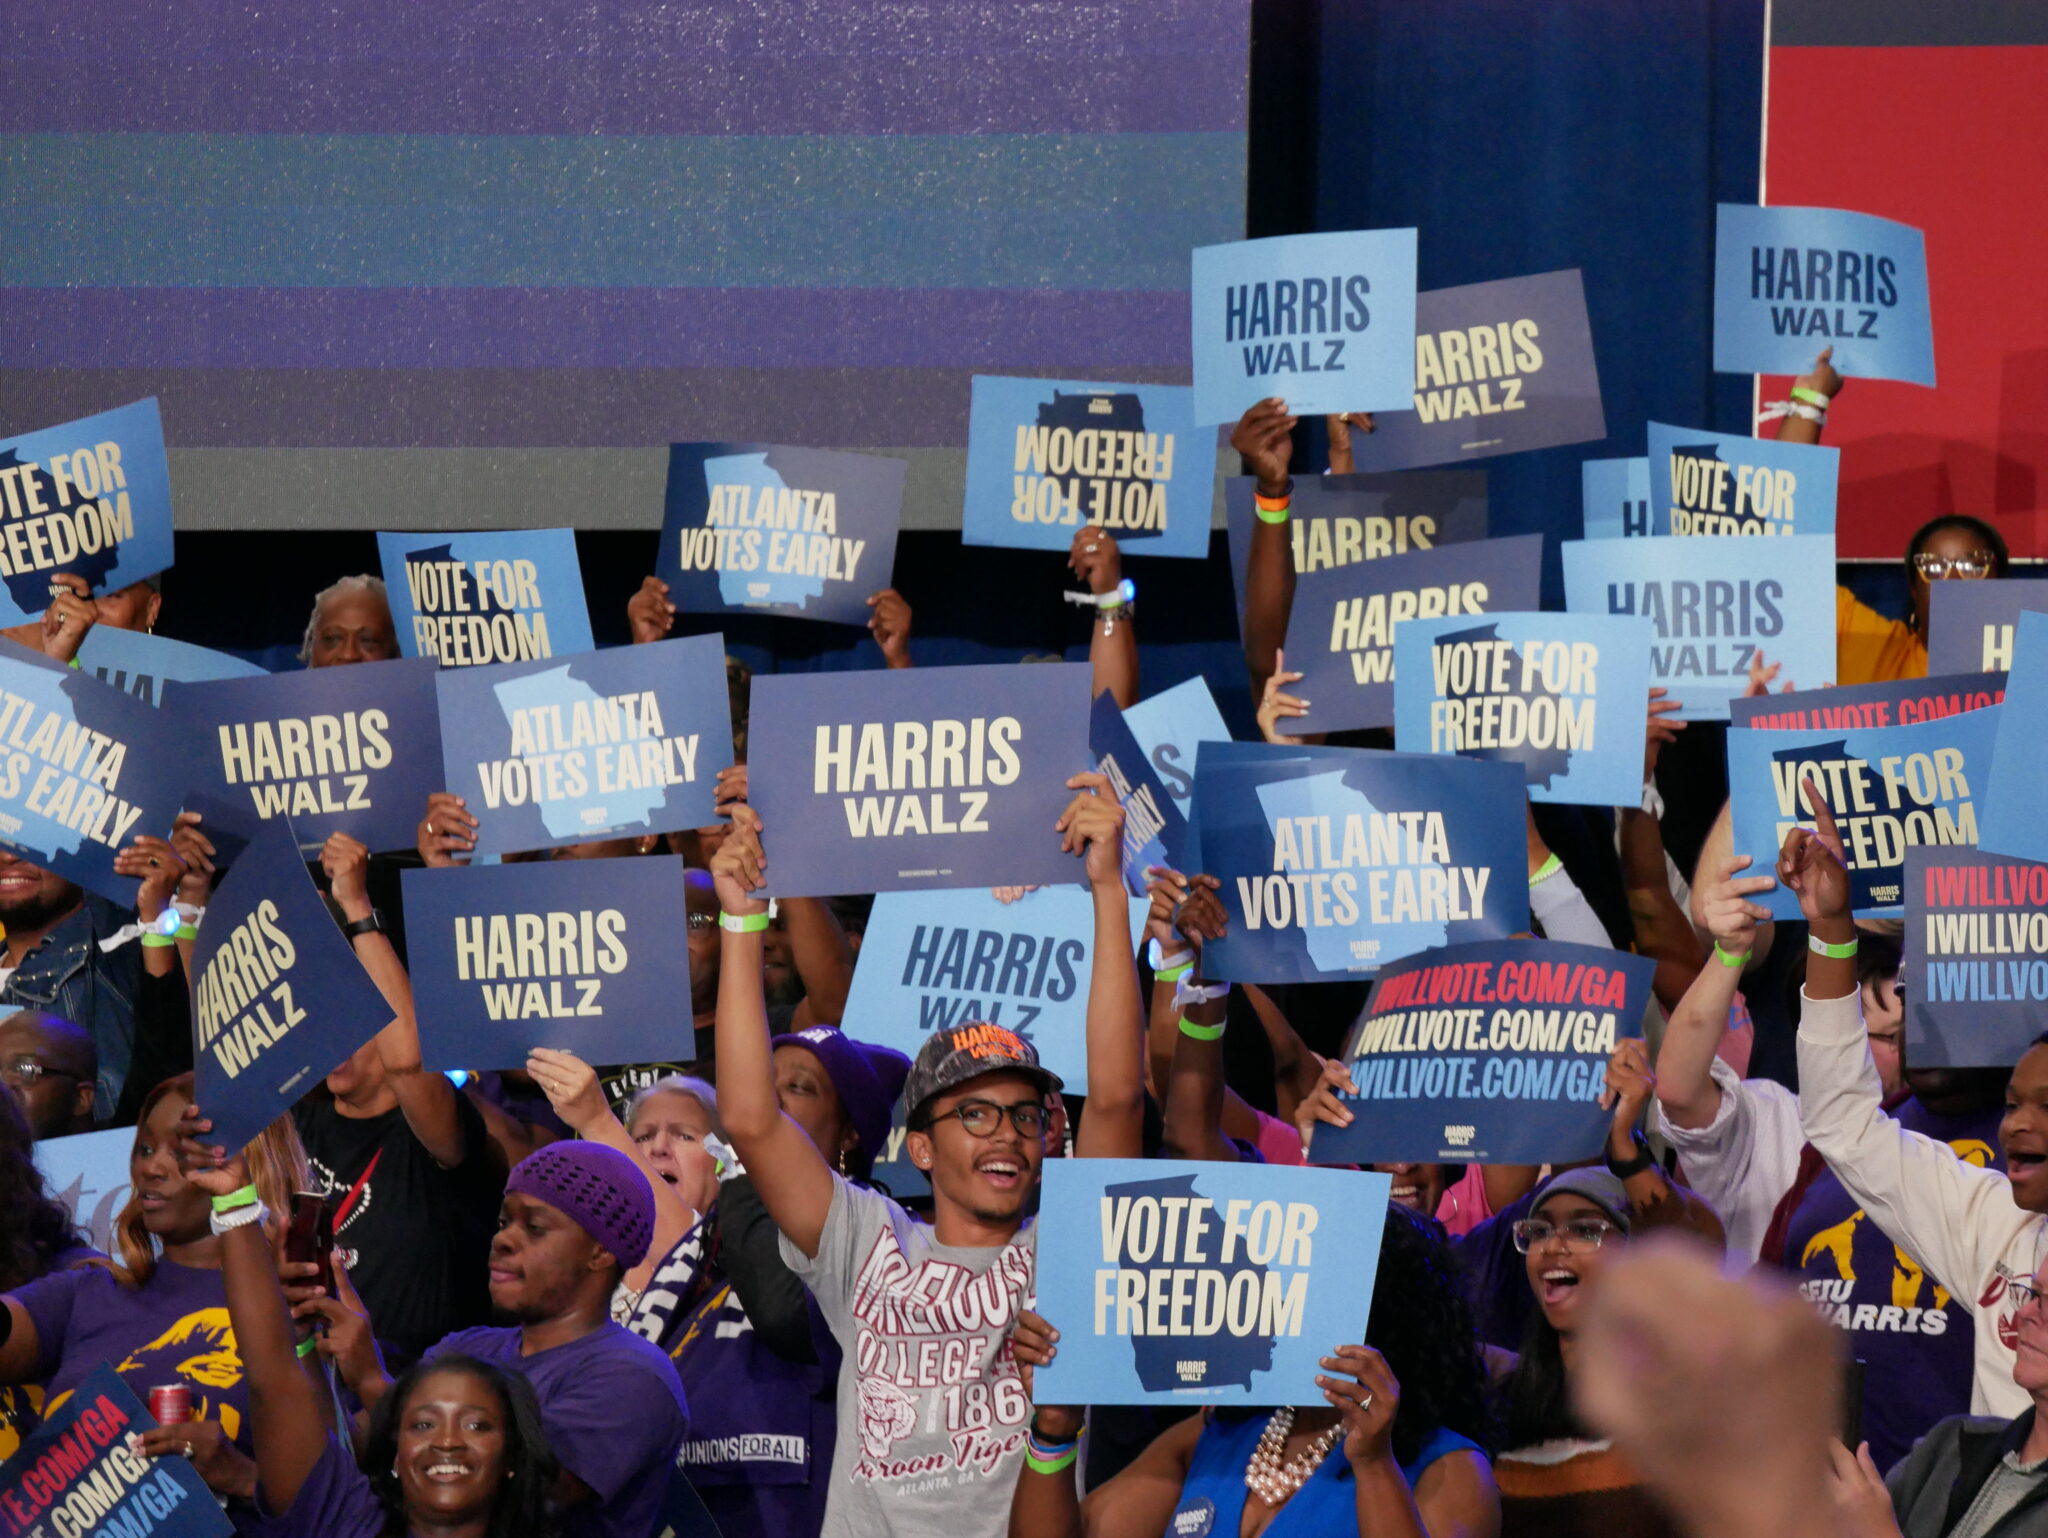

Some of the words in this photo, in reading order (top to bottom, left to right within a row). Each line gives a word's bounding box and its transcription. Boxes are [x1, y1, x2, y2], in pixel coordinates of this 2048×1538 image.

[1751, 246, 1898, 307] HARRIS
[1225, 275, 1370, 342] HARRIS
[1770, 306, 1879, 339] WALZ
[1243, 339, 1345, 377] WALZ
[1414, 318, 1543, 390] ARRIS
[1414, 378, 1526, 424] WALZ
[0, 462, 49, 522] TE
[50, 441, 127, 508] FOR
[1014, 425, 1175, 481] FREEDOM
[706, 484, 837, 535] ATLANTA
[1011, 475, 1080, 525] FOR
[1087, 480, 1168, 530] VOTE
[1670, 454, 1729, 513] VOTE
[1735, 464, 1796, 520] FOR
[680, 528, 760, 571] VOTES
[766, 535, 865, 582] EARLY
[405, 561, 471, 612] VOTE
[475, 559, 542, 611] FOR
[1608, 579, 1784, 638] HARRIS
[412, 612, 552, 666] FREEDOM
[1431, 640, 1512, 697] VOTE
[1521, 640, 1598, 694] FOR
[0, 689, 127, 792] TLANTA
[218, 708, 393, 784] HARRIS
[510, 691, 665, 758] ATLANTA
[1431, 696, 1596, 753] FREEDOM
[478, 750, 588, 809] VOTES
[598, 733, 700, 793] EARLY
[814, 716, 1022, 794] HARRIS
[1770, 760, 1876, 816] VOTE
[1880, 748, 1970, 809] FOR
[25, 765, 143, 850] EARLY
[250, 774, 371, 819] WALZ
[843, 791, 989, 838] WALZ
[1273, 811, 1451, 872] ATLANTA
[1236, 871, 1360, 930] VOTES
[1369, 867, 1491, 924] EARLY
[454, 908, 628, 981] HARRIS
[901, 925, 1085, 1003] HARRIS
[197, 899, 296, 1052] HARRIS
[481, 979, 603, 1021] WALZ
[1370, 961, 1627, 1015] IWILLVOTE.COM/GA
[213, 981, 307, 1079] WALZ
[953, 1024, 1024, 1051] HARRIS
[1354, 1008, 1616, 1057] IWILLVOTE.COM/GA
[1100, 1195, 1214, 1264] VOTE
[1220, 1199, 1319, 1267] FOR
[1094, 1269, 1310, 1337] FREEDOM
[856, 1328, 988, 1388] OLLEGE
[1176, 1360, 1207, 1374] HARRIS
[1180, 1373, 1202, 1382] WALZ
